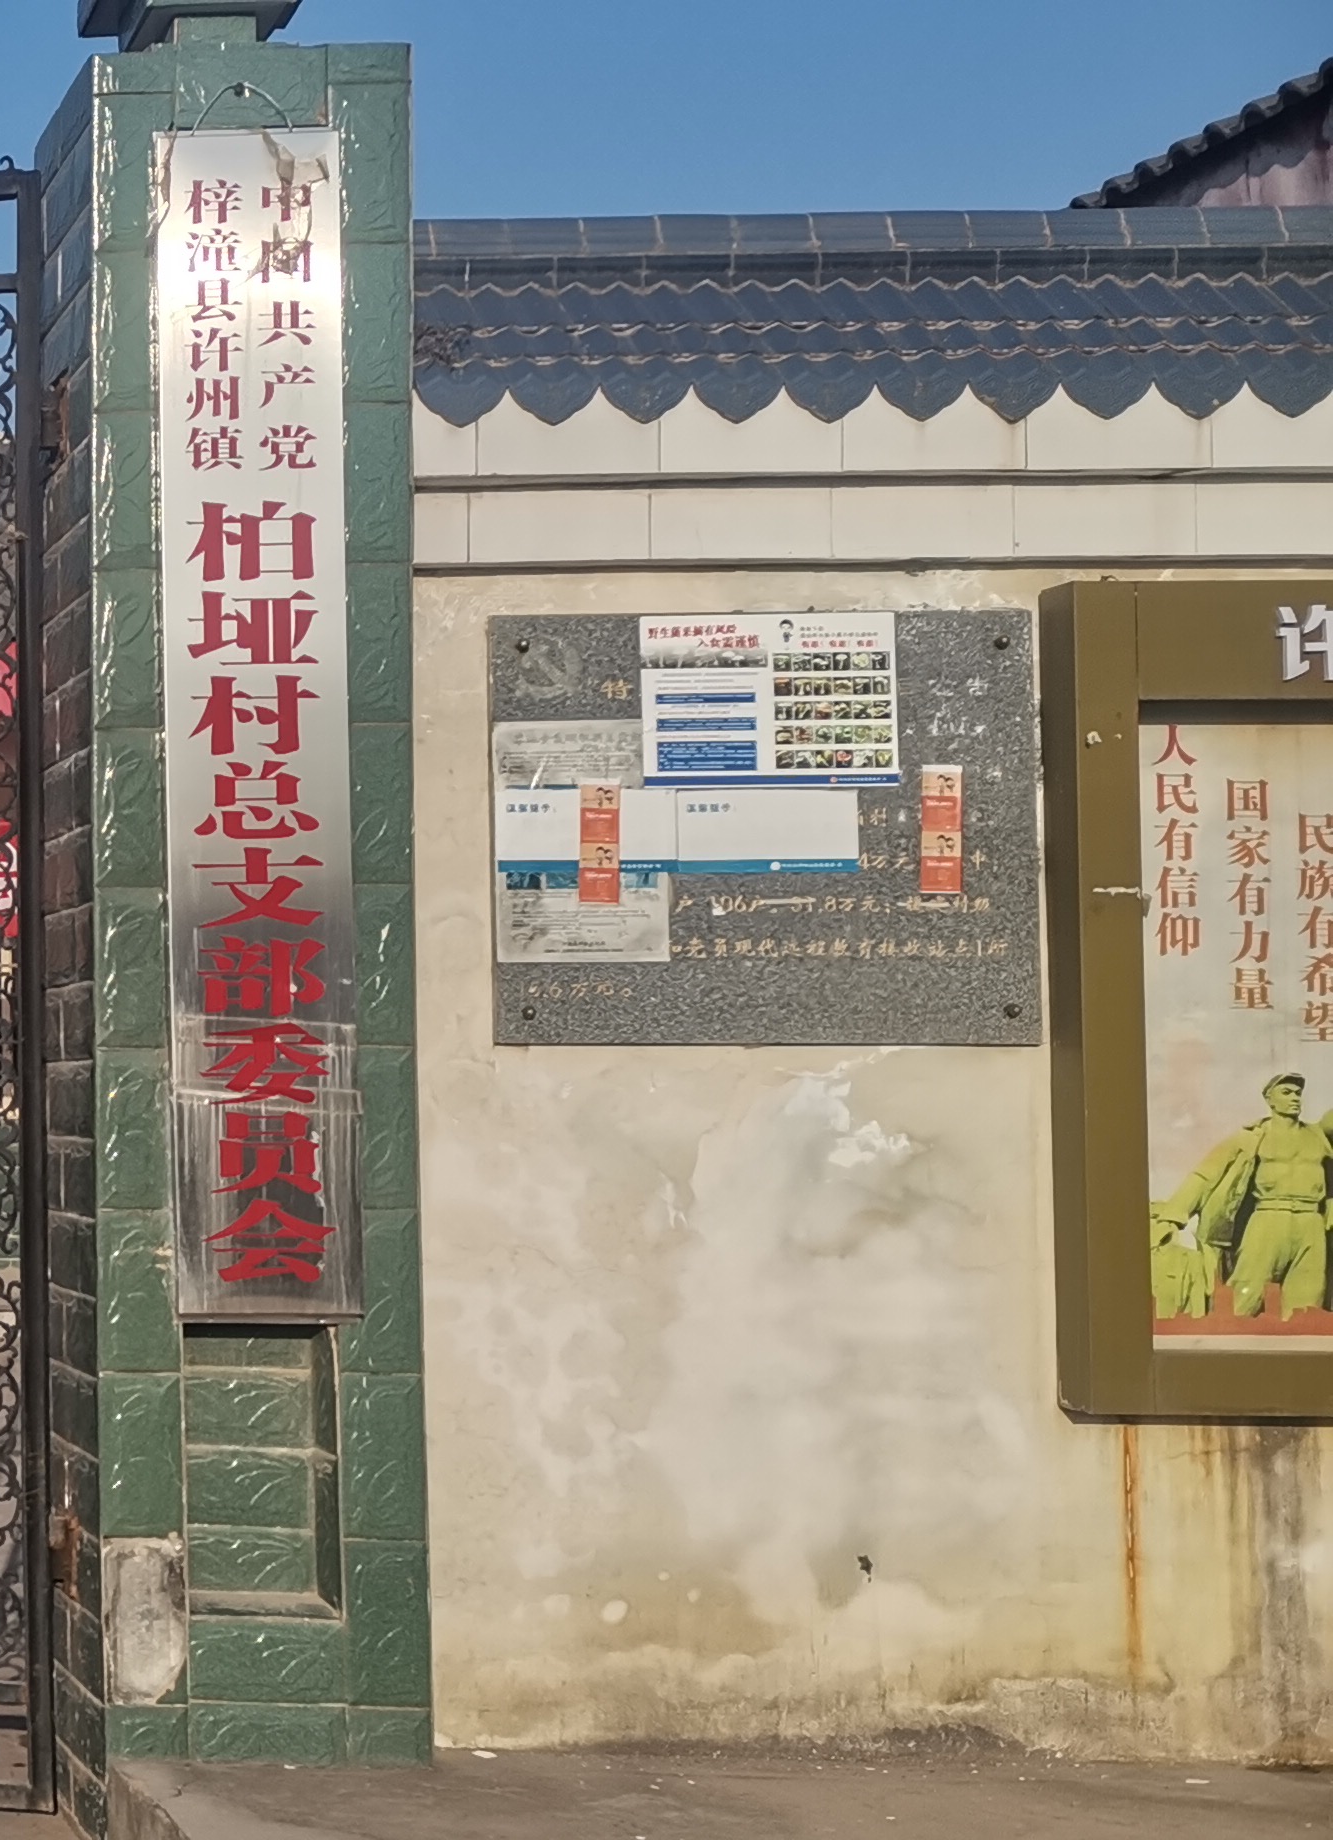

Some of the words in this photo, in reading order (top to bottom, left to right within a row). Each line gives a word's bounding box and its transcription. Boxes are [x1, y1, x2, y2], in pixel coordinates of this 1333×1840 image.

[185, 178, 244, 472] 梓潼县许州镇
[185, 501, 337, 1283] 柏垭村总支部委员会
[1151, 723, 1202, 957] 人民有信仰
[1225, 778, 1274, 1011] 国家有力量
[1296, 811, 1333, 1043] 民族有希望
